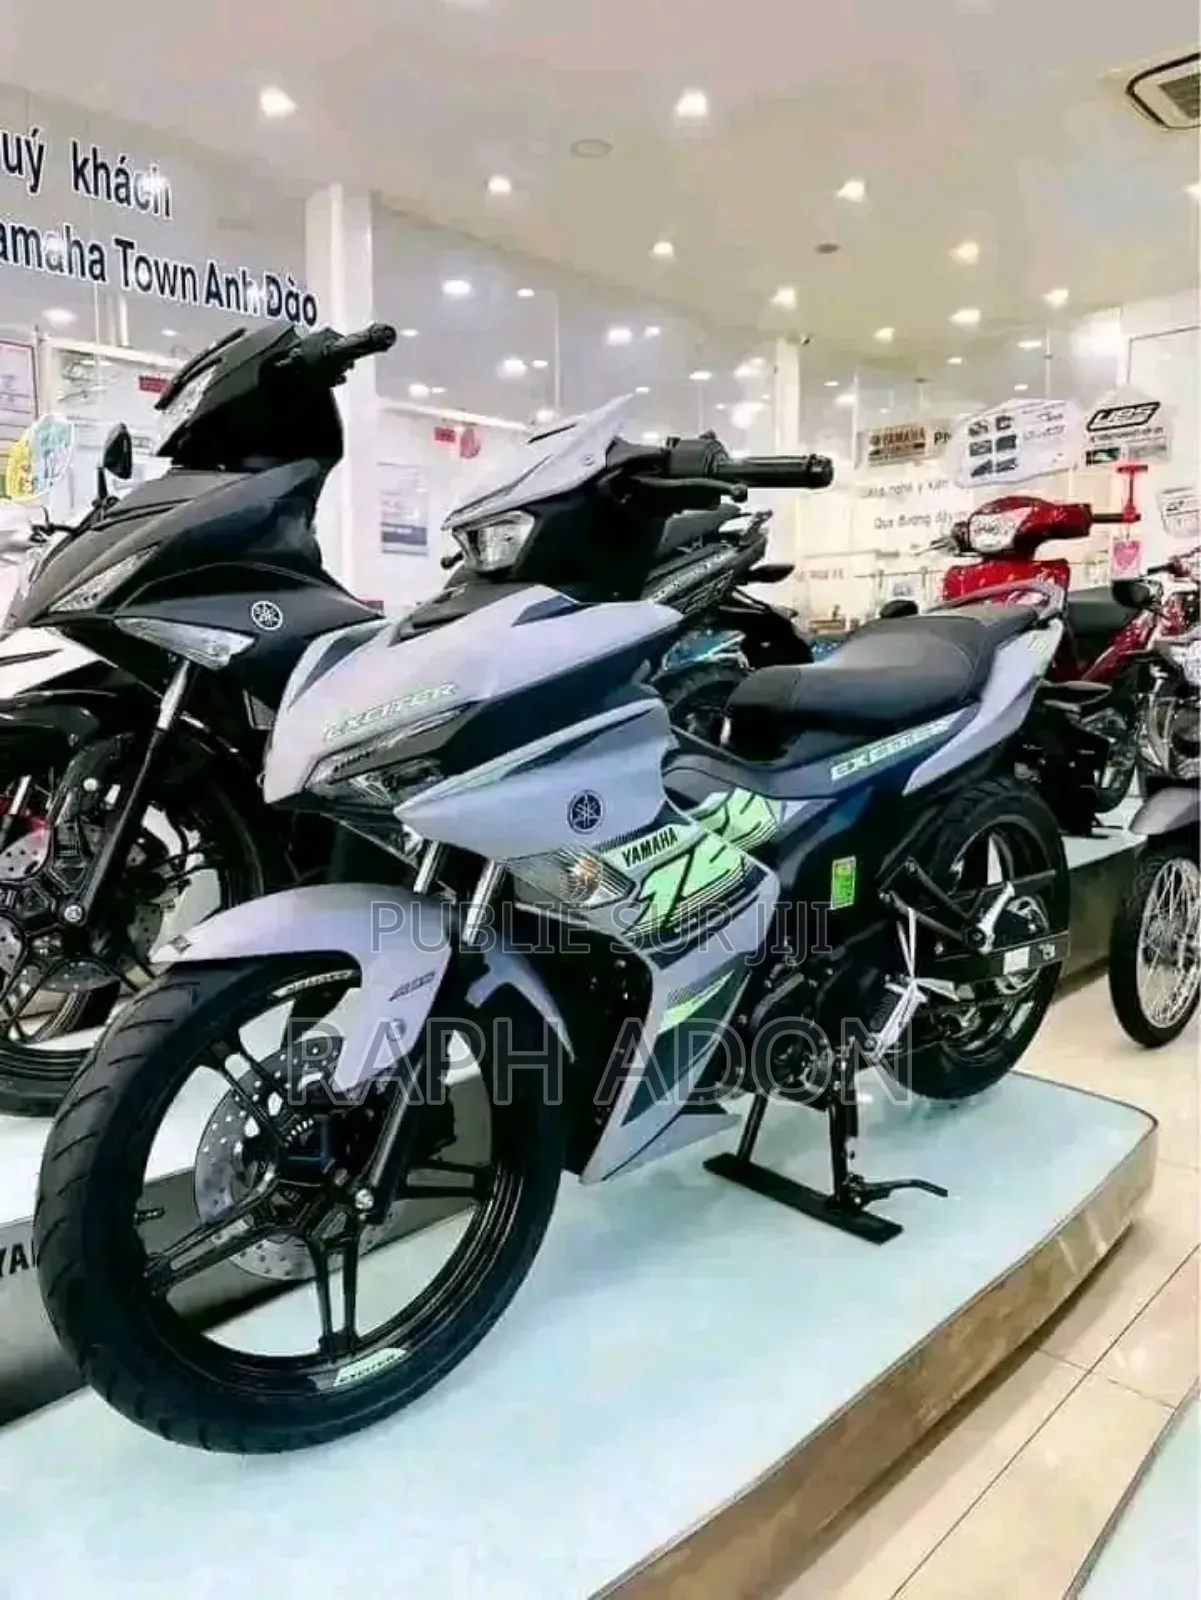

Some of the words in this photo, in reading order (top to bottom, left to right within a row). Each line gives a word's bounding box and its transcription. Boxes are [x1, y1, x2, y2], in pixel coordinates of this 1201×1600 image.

[114, 237, 198, 302] Town
[204, 261, 258, 314] Anh
[621, 827, 678, 868] YAMAHA
